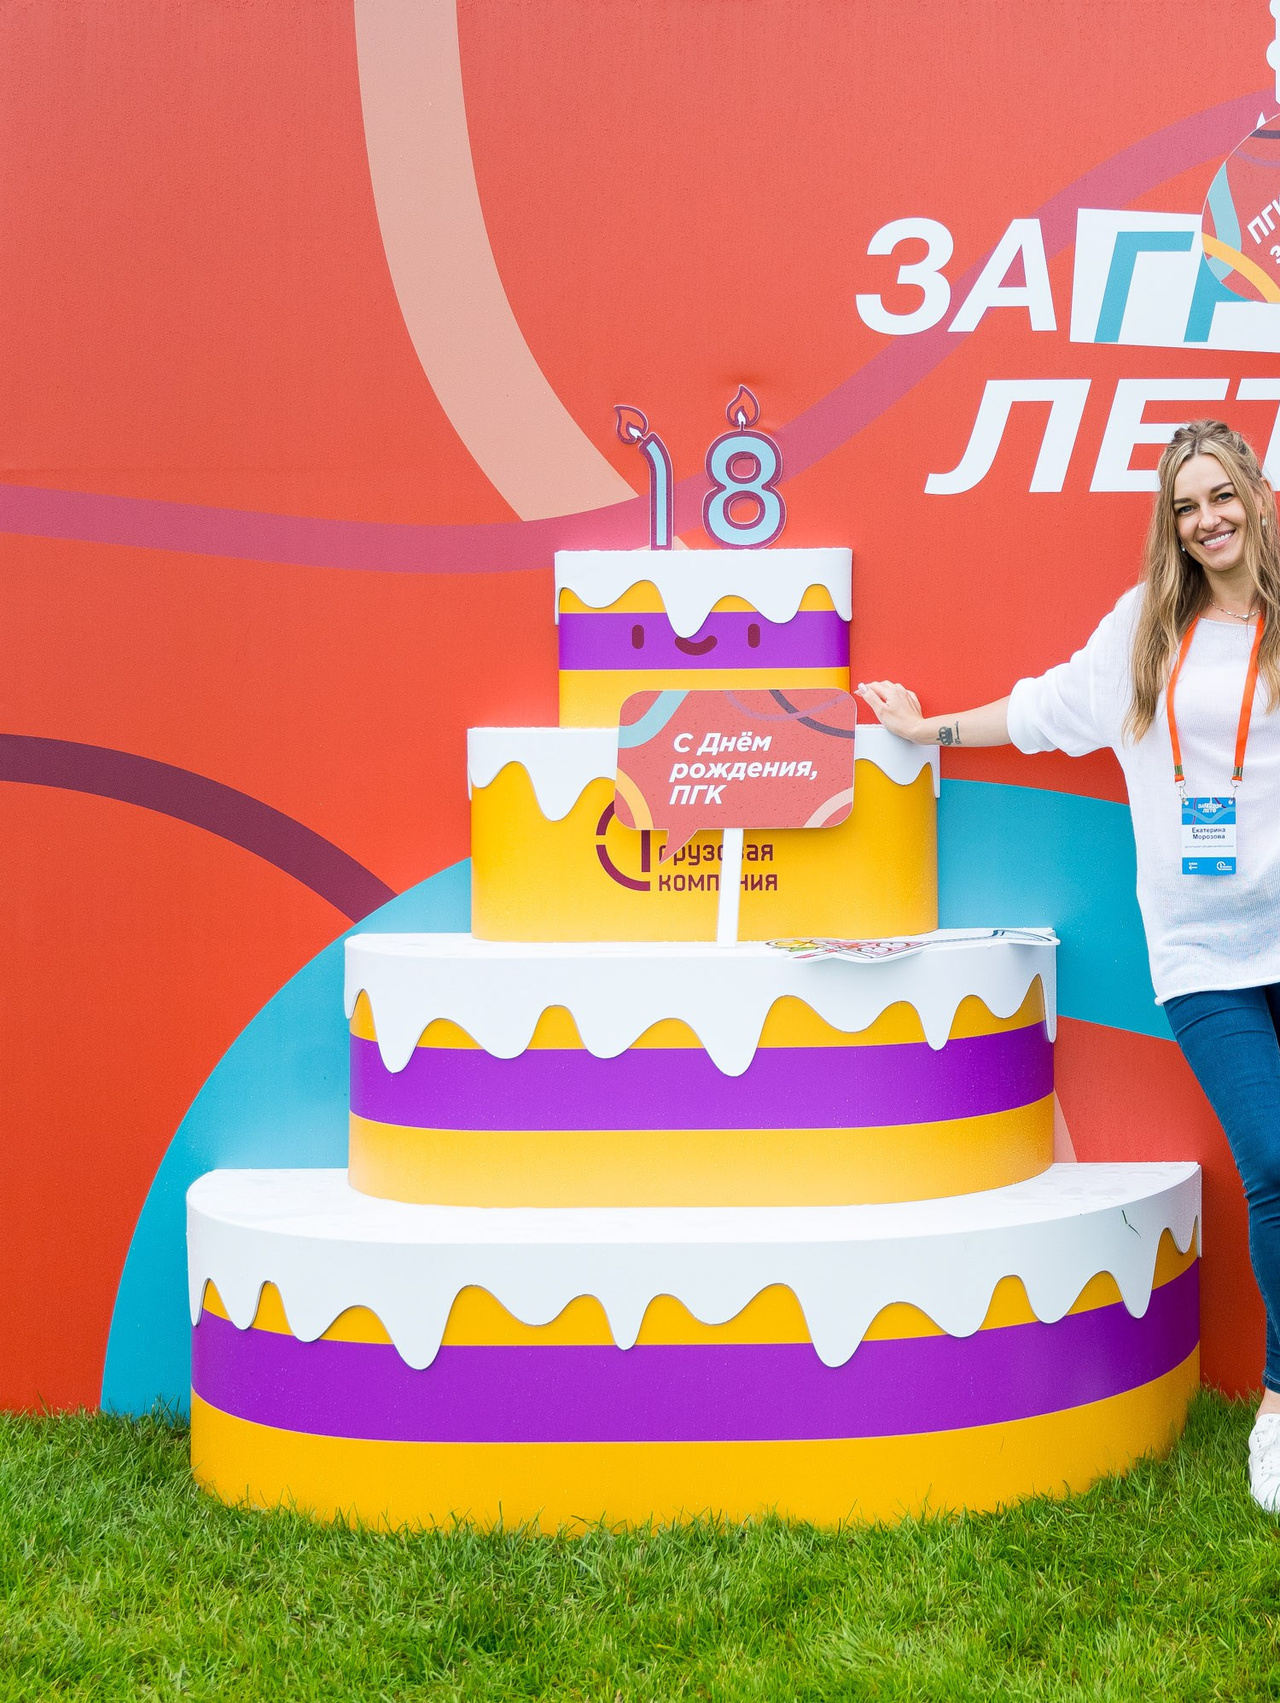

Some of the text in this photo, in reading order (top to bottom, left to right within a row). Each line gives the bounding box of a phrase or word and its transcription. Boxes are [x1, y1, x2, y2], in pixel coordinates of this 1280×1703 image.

[638, 431, 788, 550] 18
[672, 731, 773, 756] С Днём
[668, 760, 818, 783] рождения,
[669, 784, 728, 805] ПГК
[658, 844, 774, 866] грузая
[658, 874, 778, 892] компния
